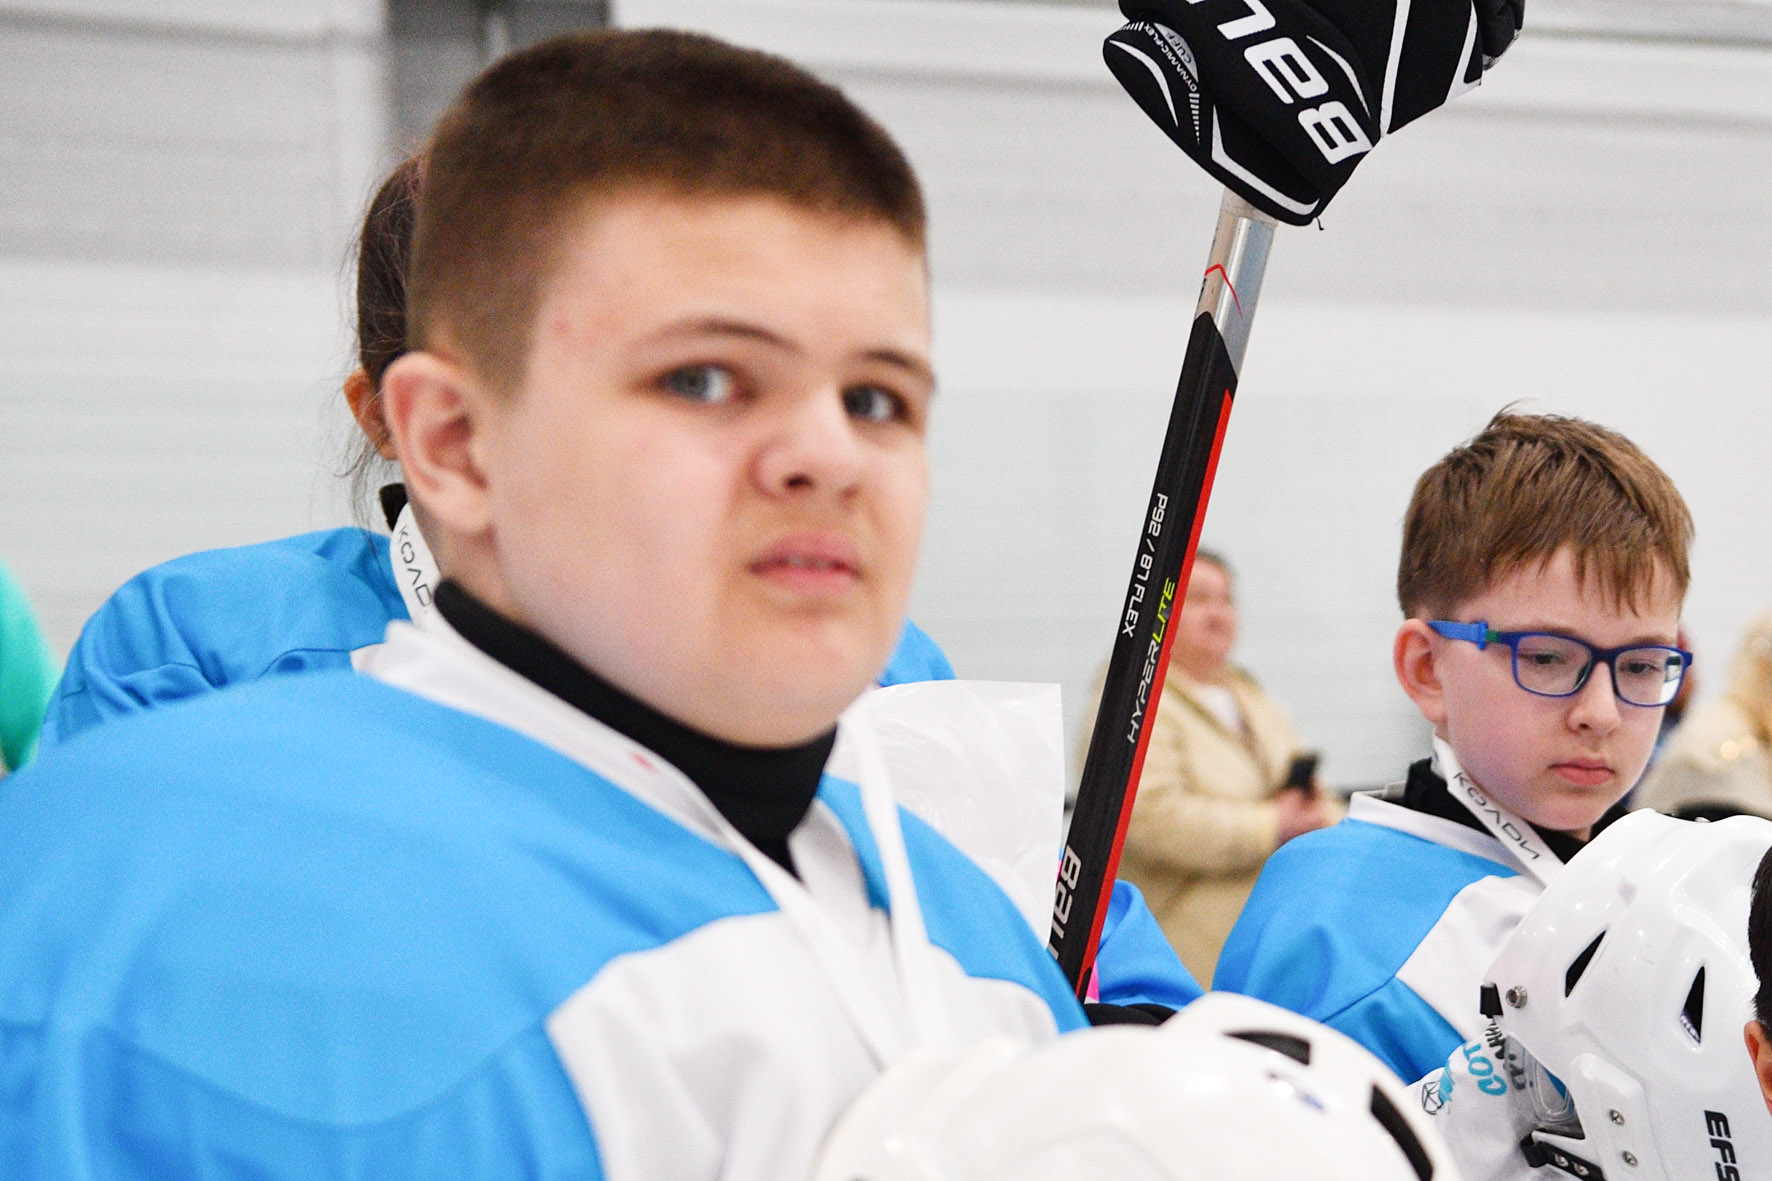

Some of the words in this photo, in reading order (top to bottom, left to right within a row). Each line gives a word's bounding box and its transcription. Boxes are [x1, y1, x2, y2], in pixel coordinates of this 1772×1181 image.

[1148, 492, 1169, 537] P92
[1122, 582, 1146, 638] FLEX
[1127, 577, 1176, 744] HYPERLITE
[1463, 1043, 1507, 1096] СОТ
